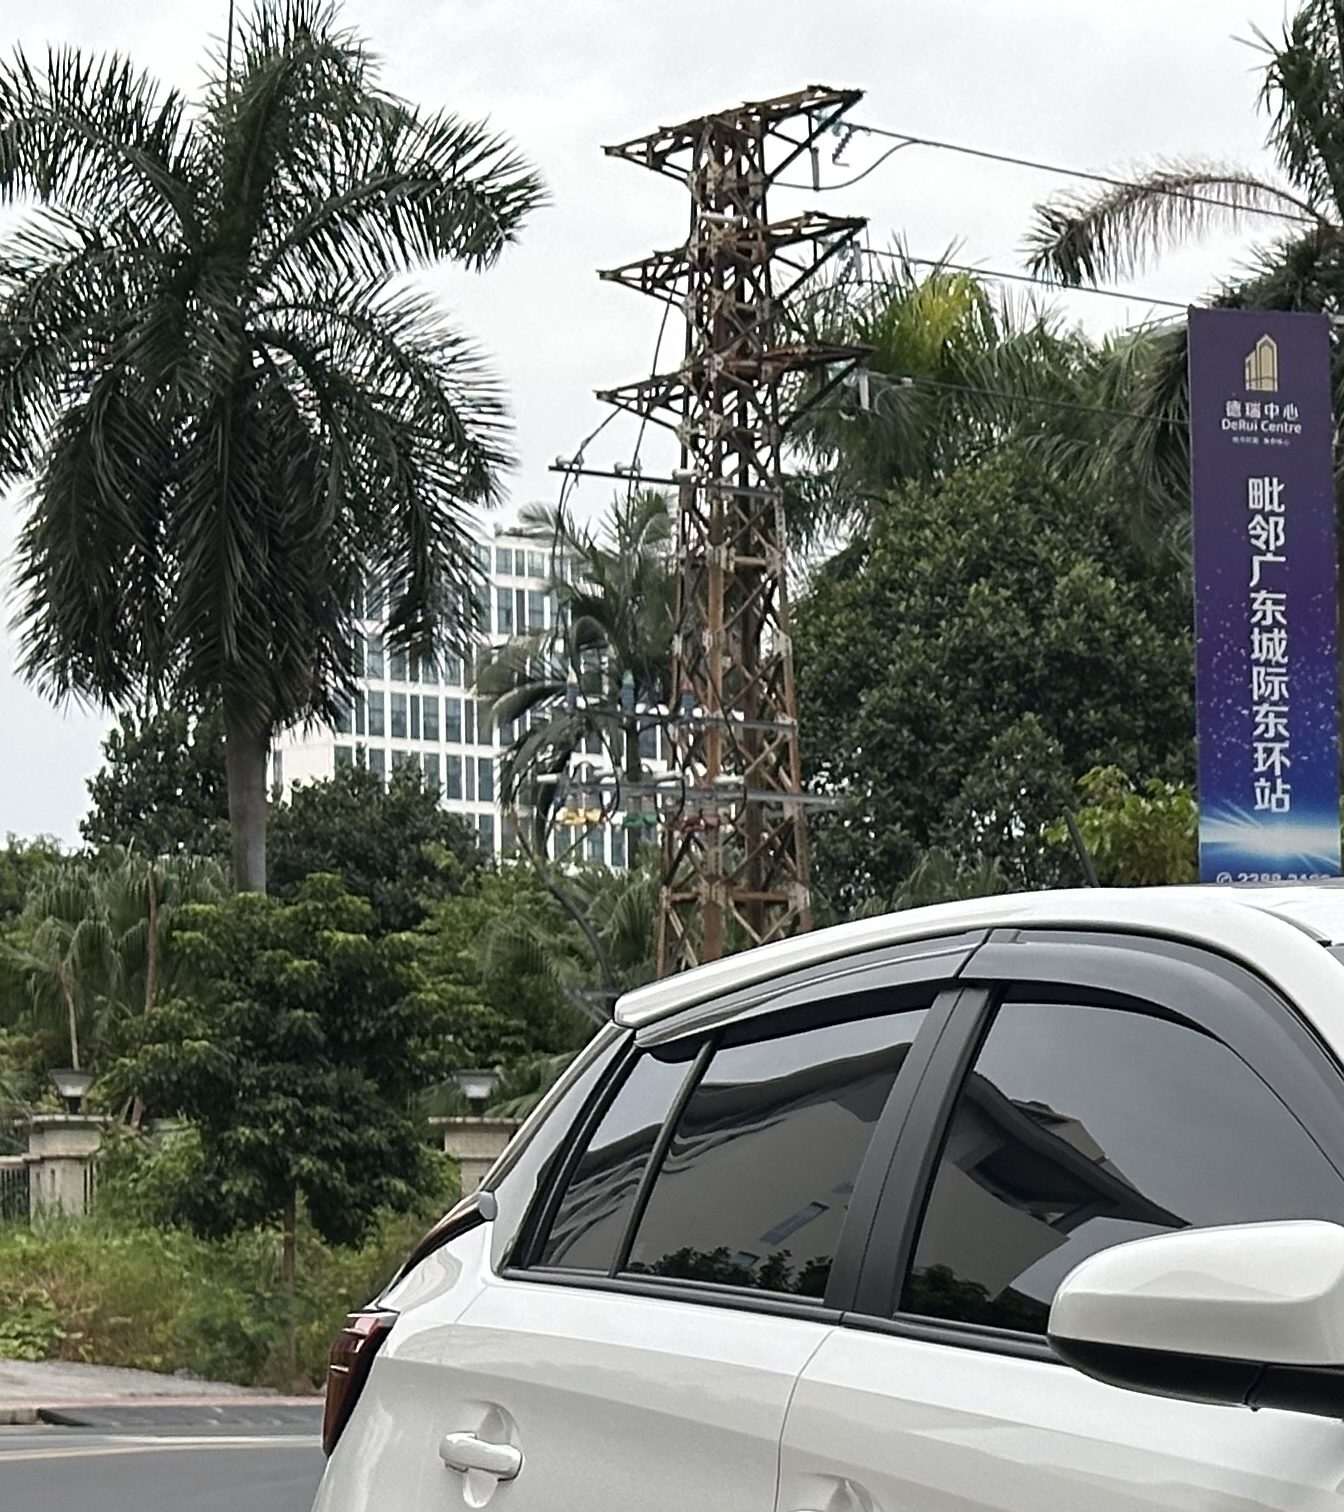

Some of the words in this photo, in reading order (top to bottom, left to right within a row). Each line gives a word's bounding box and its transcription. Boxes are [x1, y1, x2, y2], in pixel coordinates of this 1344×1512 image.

[1226, 400, 1299, 421] 德瑞中心
[1222, 418, 1258, 432] DeRui
[1261, 420, 1302, 434] Centre
[1248, 476, 1291, 814] 毗邻广东城际东环站
